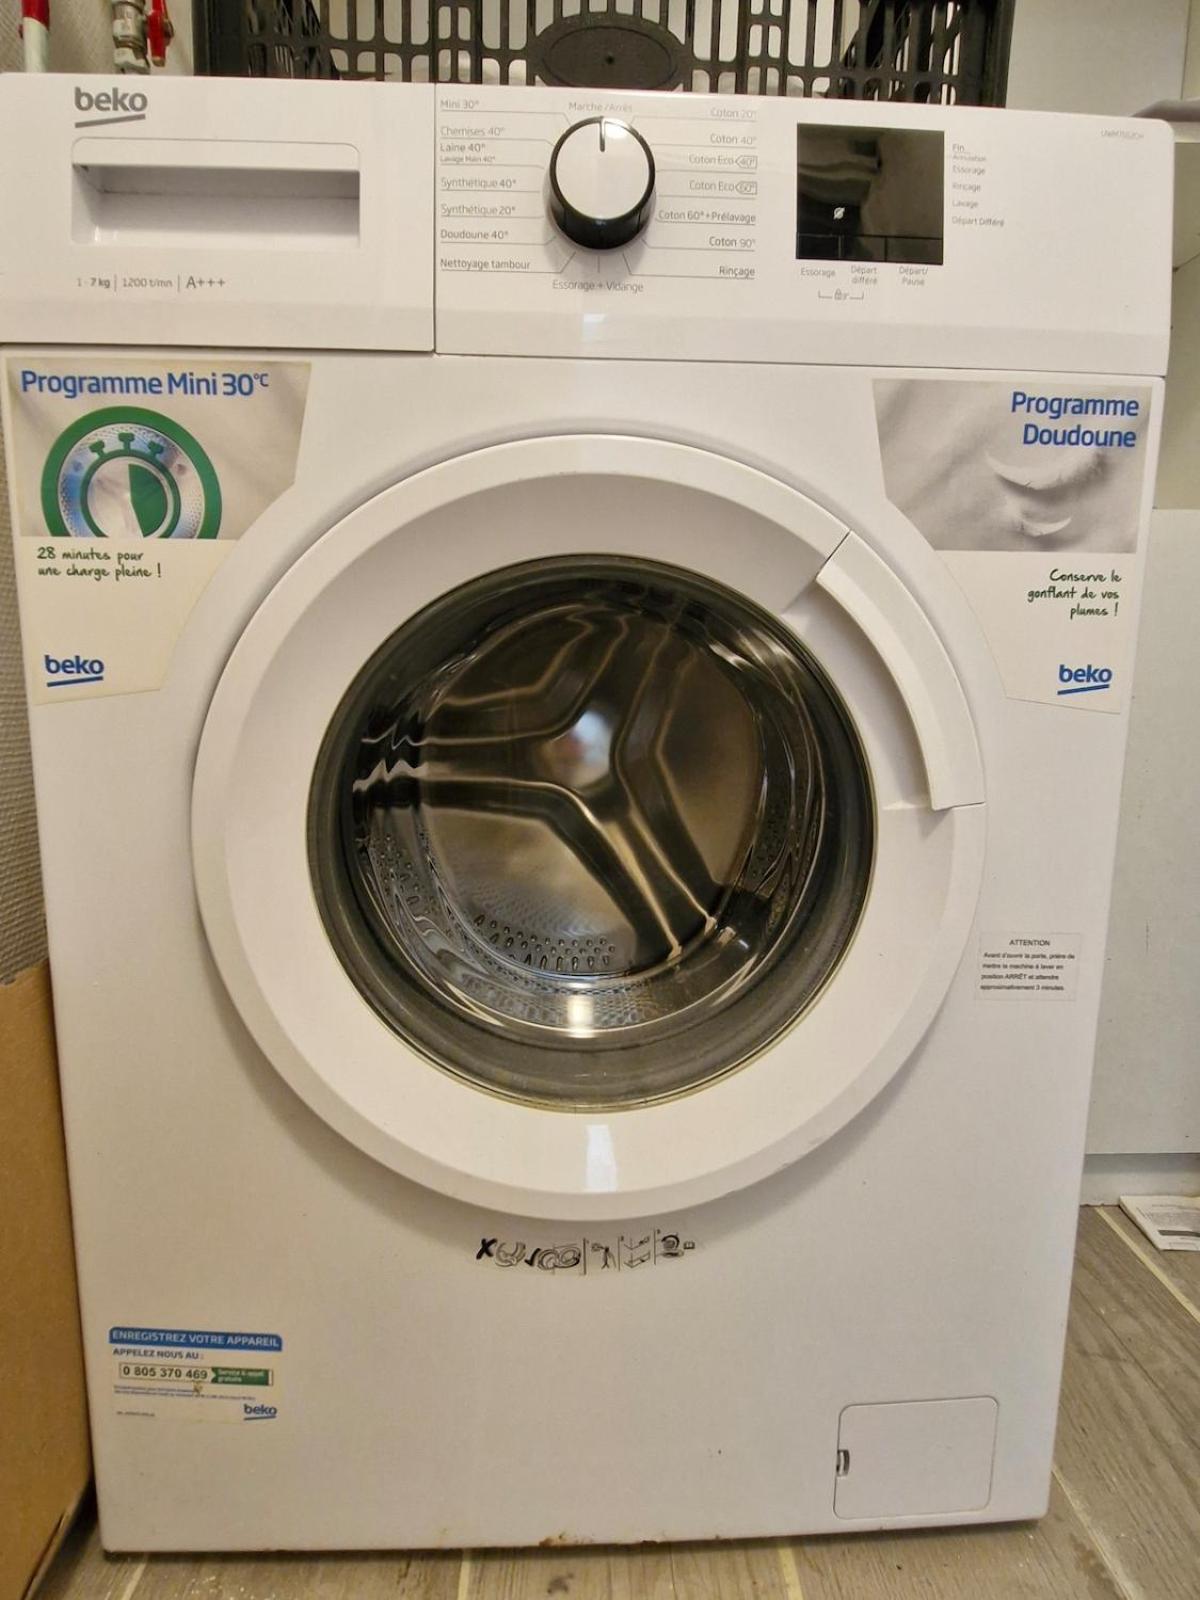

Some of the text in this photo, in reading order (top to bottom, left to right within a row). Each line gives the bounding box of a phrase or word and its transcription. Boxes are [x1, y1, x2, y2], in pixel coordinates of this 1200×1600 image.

[74, 86, 148, 113] beko
[440, 99, 480, 109] Mini 30°
[568, 101, 602, 112] Marche
[710, 107, 739, 118] Coton
[440, 126, 486, 137] Chemises
[710, 132, 738, 144] Coton
[440, 143, 467, 152] Laine
[688, 154, 717, 164] Coton
[441, 177, 498, 190] Synthétique
[689, 179, 735, 192] Coton Eco
[440, 203, 498, 217] Synthétique
[658, 209, 686, 220] Coton
[440, 229, 489, 239] Doudoune
[709, 236, 738, 247] Coton
[440, 258, 531, 271] Nettoyage tambour
[719, 265, 756, 279] Rinçage
[122, 277, 148, 288] 1200
[186, 274, 226, 290] A+++
[552, 279, 595, 292] Essorage
[606, 280, 644, 294] Vidange
[21, 370, 163, 399] Programme
[167, 373, 218, 396] Mini
[1011, 391, 1140, 420] Programme
[1022, 423, 1138, 448] Doudoune
[37, 547, 145, 566] 28 minutes pour
[38, 566, 61, 577] une
[66, 564, 110, 582] charge
[115, 564, 152, 581] pleine
[1049, 568, 1122, 583] Conserve le
[1027, 585, 1120, 603] gonflant de vos
[1070, 603, 1109, 620] plumes
[45, 655, 105, 675] beko
[1058, 664, 1112, 683] beko
[1008, 939, 1051, 947] ATTENTION
[112, 1330, 280, 1348] ENREGISTREZ VOTRE APPAREIL
[113, 1347, 155, 1358] APPELEZ
[156, 1350, 184, 1359] NOUS
[185, 1351, 199, 1360] AU
[122, 1365, 208, 1380] 0 805 370 469
[243, 1403, 278, 1416] beko
